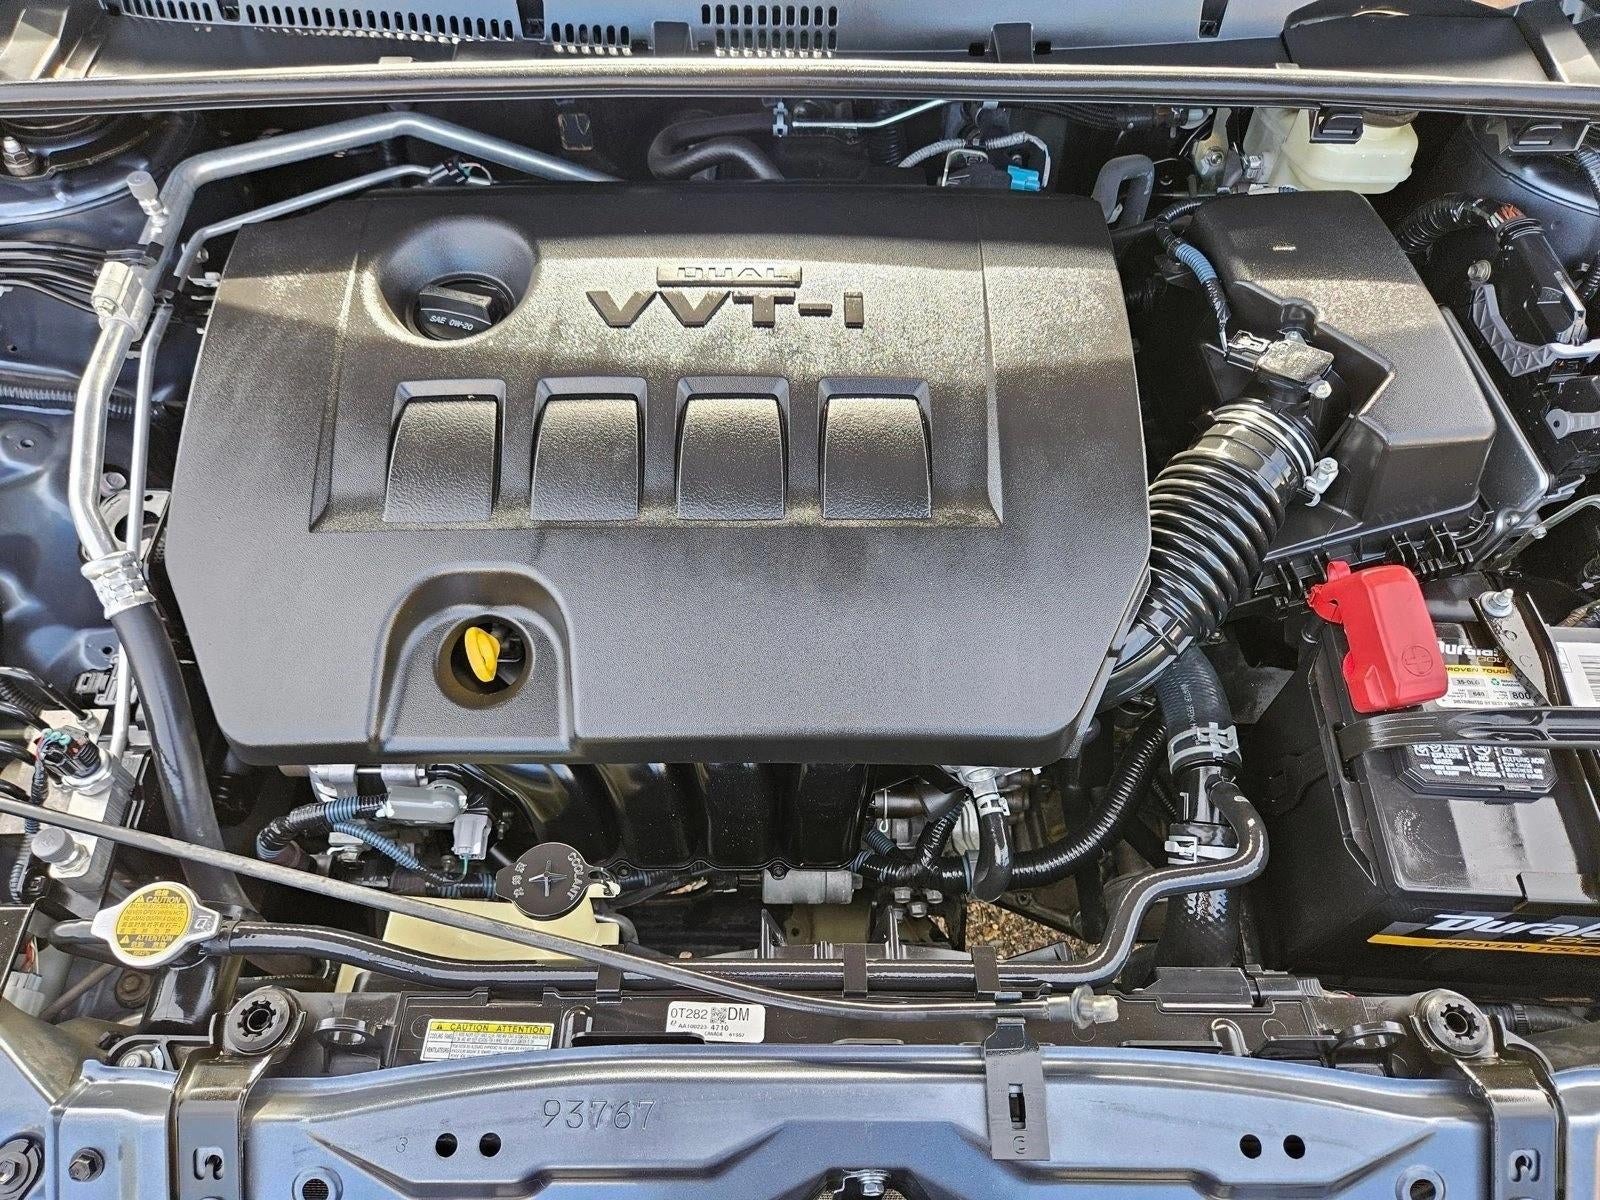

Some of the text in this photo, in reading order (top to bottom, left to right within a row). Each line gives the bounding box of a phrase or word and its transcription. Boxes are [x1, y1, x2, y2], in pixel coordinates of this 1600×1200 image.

[677, 267, 788, 278] DUAL
[429, 315, 474, 331] SAE 0W-20
[1512, 691, 1531, 699] 800
[567, 851, 584, 900] COOLANT
[1435, 941, 1529, 950] PROVEN
[728, 1007, 750, 1021] DM
[450, 1023, 546, 1033] CAUTION ATTENTION
[543, 1099, 656, 1130] 93767
